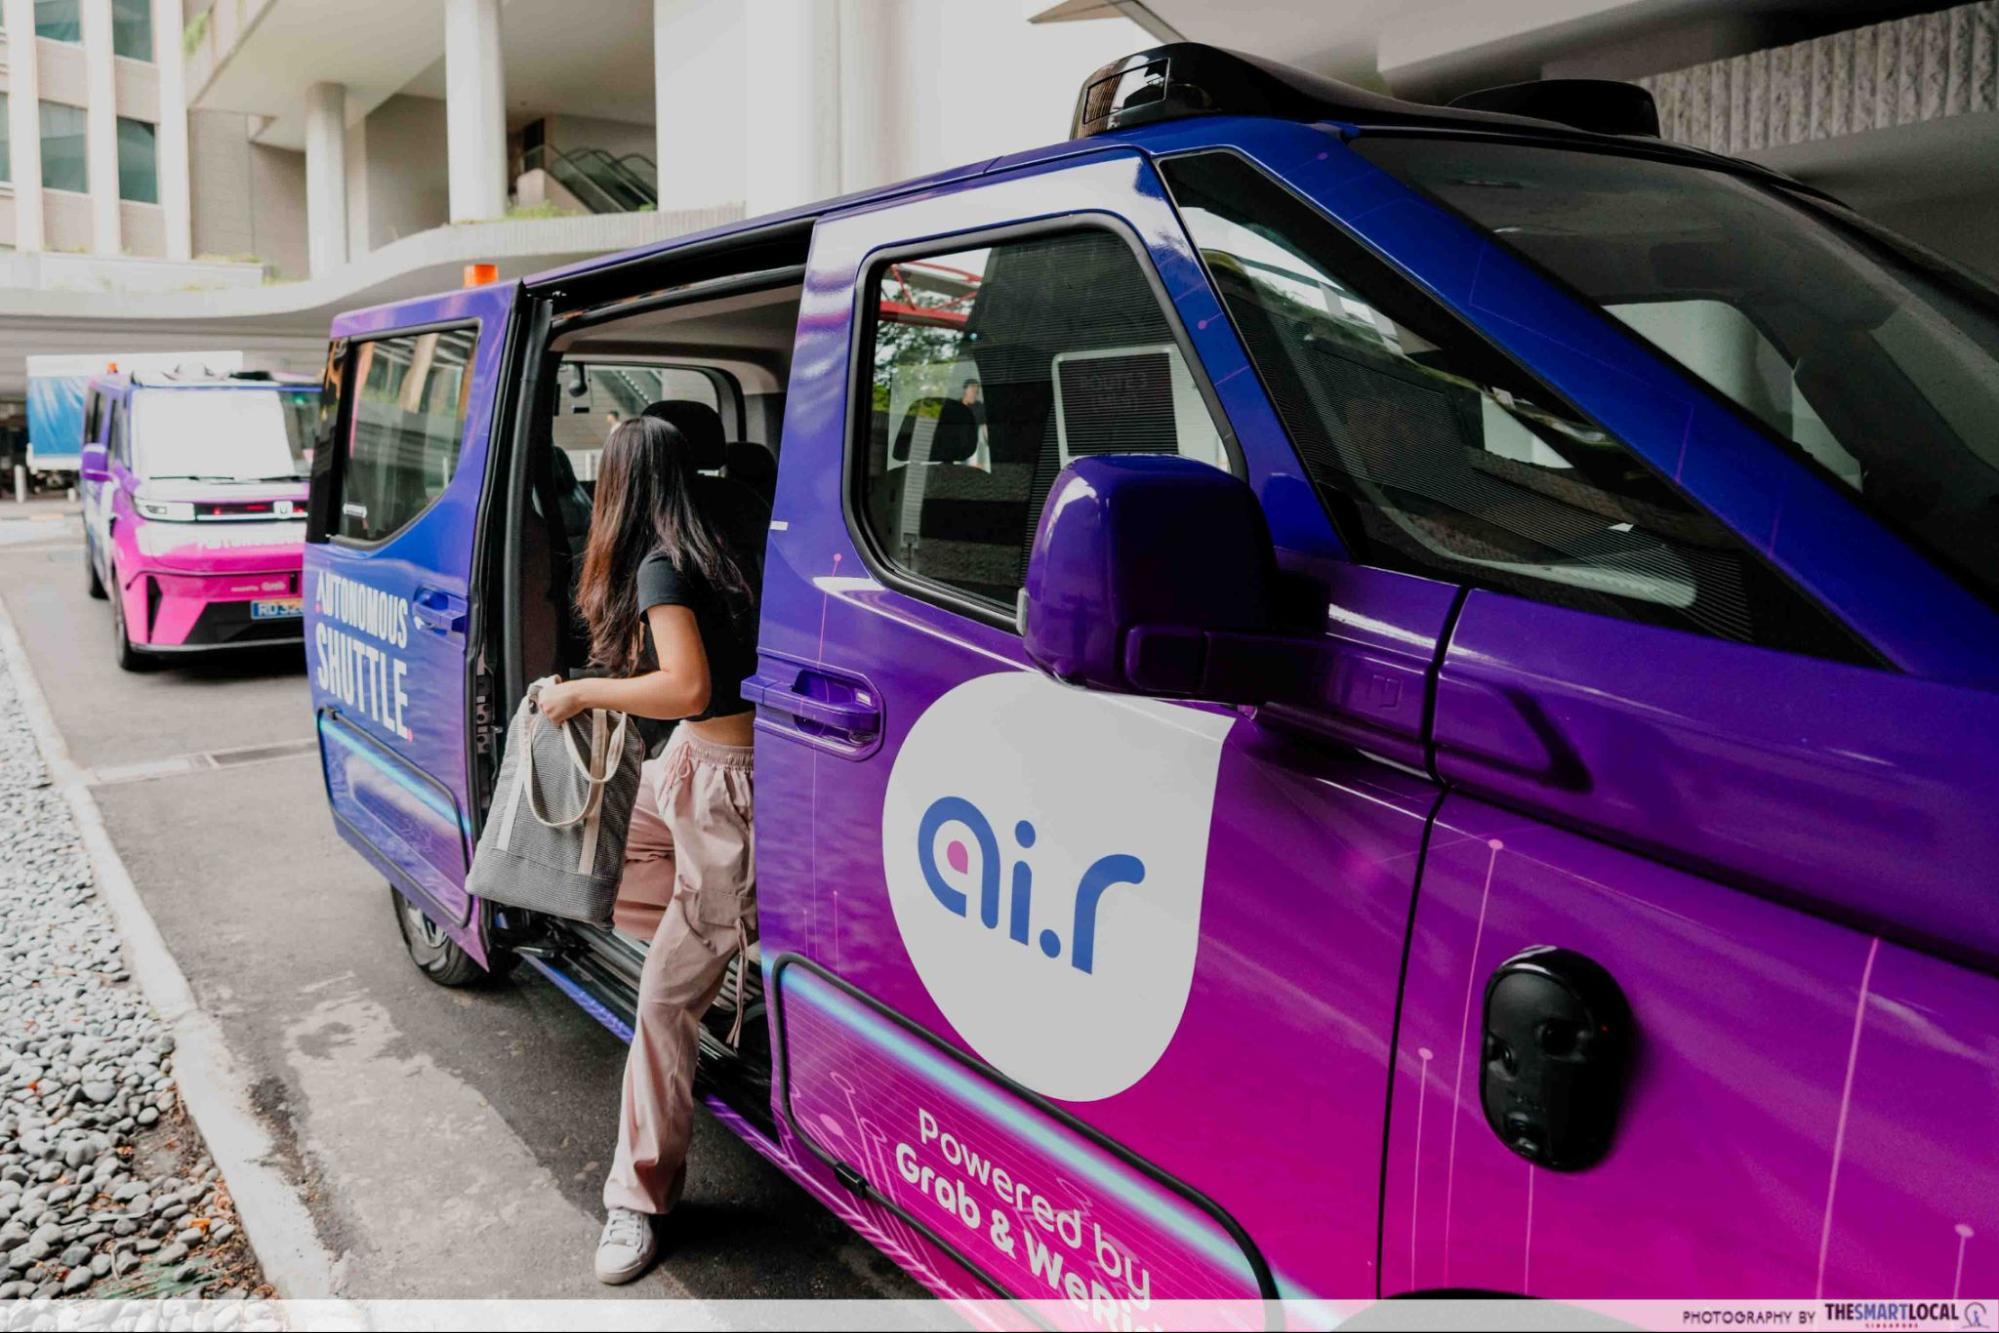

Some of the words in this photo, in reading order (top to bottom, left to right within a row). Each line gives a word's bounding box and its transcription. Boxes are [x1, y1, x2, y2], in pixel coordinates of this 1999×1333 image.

[315, 569, 409, 649] AUTONOMOUS
[895, 1143, 981, 1229] Grab
[989, 1209, 1016, 1260] &
[918, 1107, 1082, 1249] Powered
[1093, 1223, 1150, 1311] by
